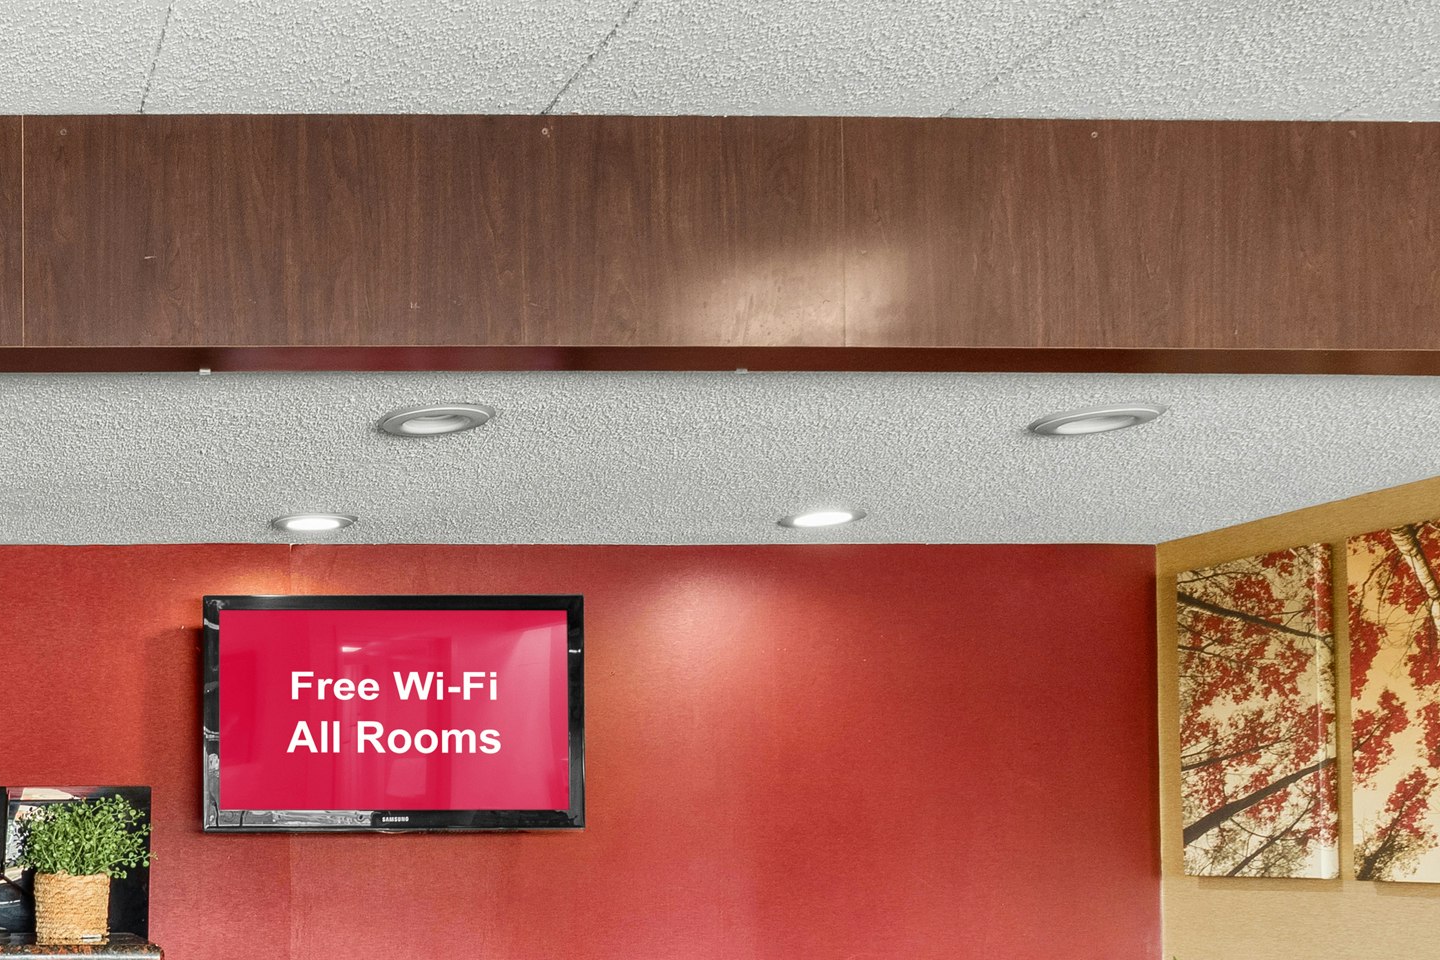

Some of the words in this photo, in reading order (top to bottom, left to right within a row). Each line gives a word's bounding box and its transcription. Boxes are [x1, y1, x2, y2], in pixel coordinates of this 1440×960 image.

[291, 671, 379, 701] Free
[392, 671, 498, 701] Wi-Fi
[286, 720, 339, 754] All
[357, 720, 501, 755] Rooms
